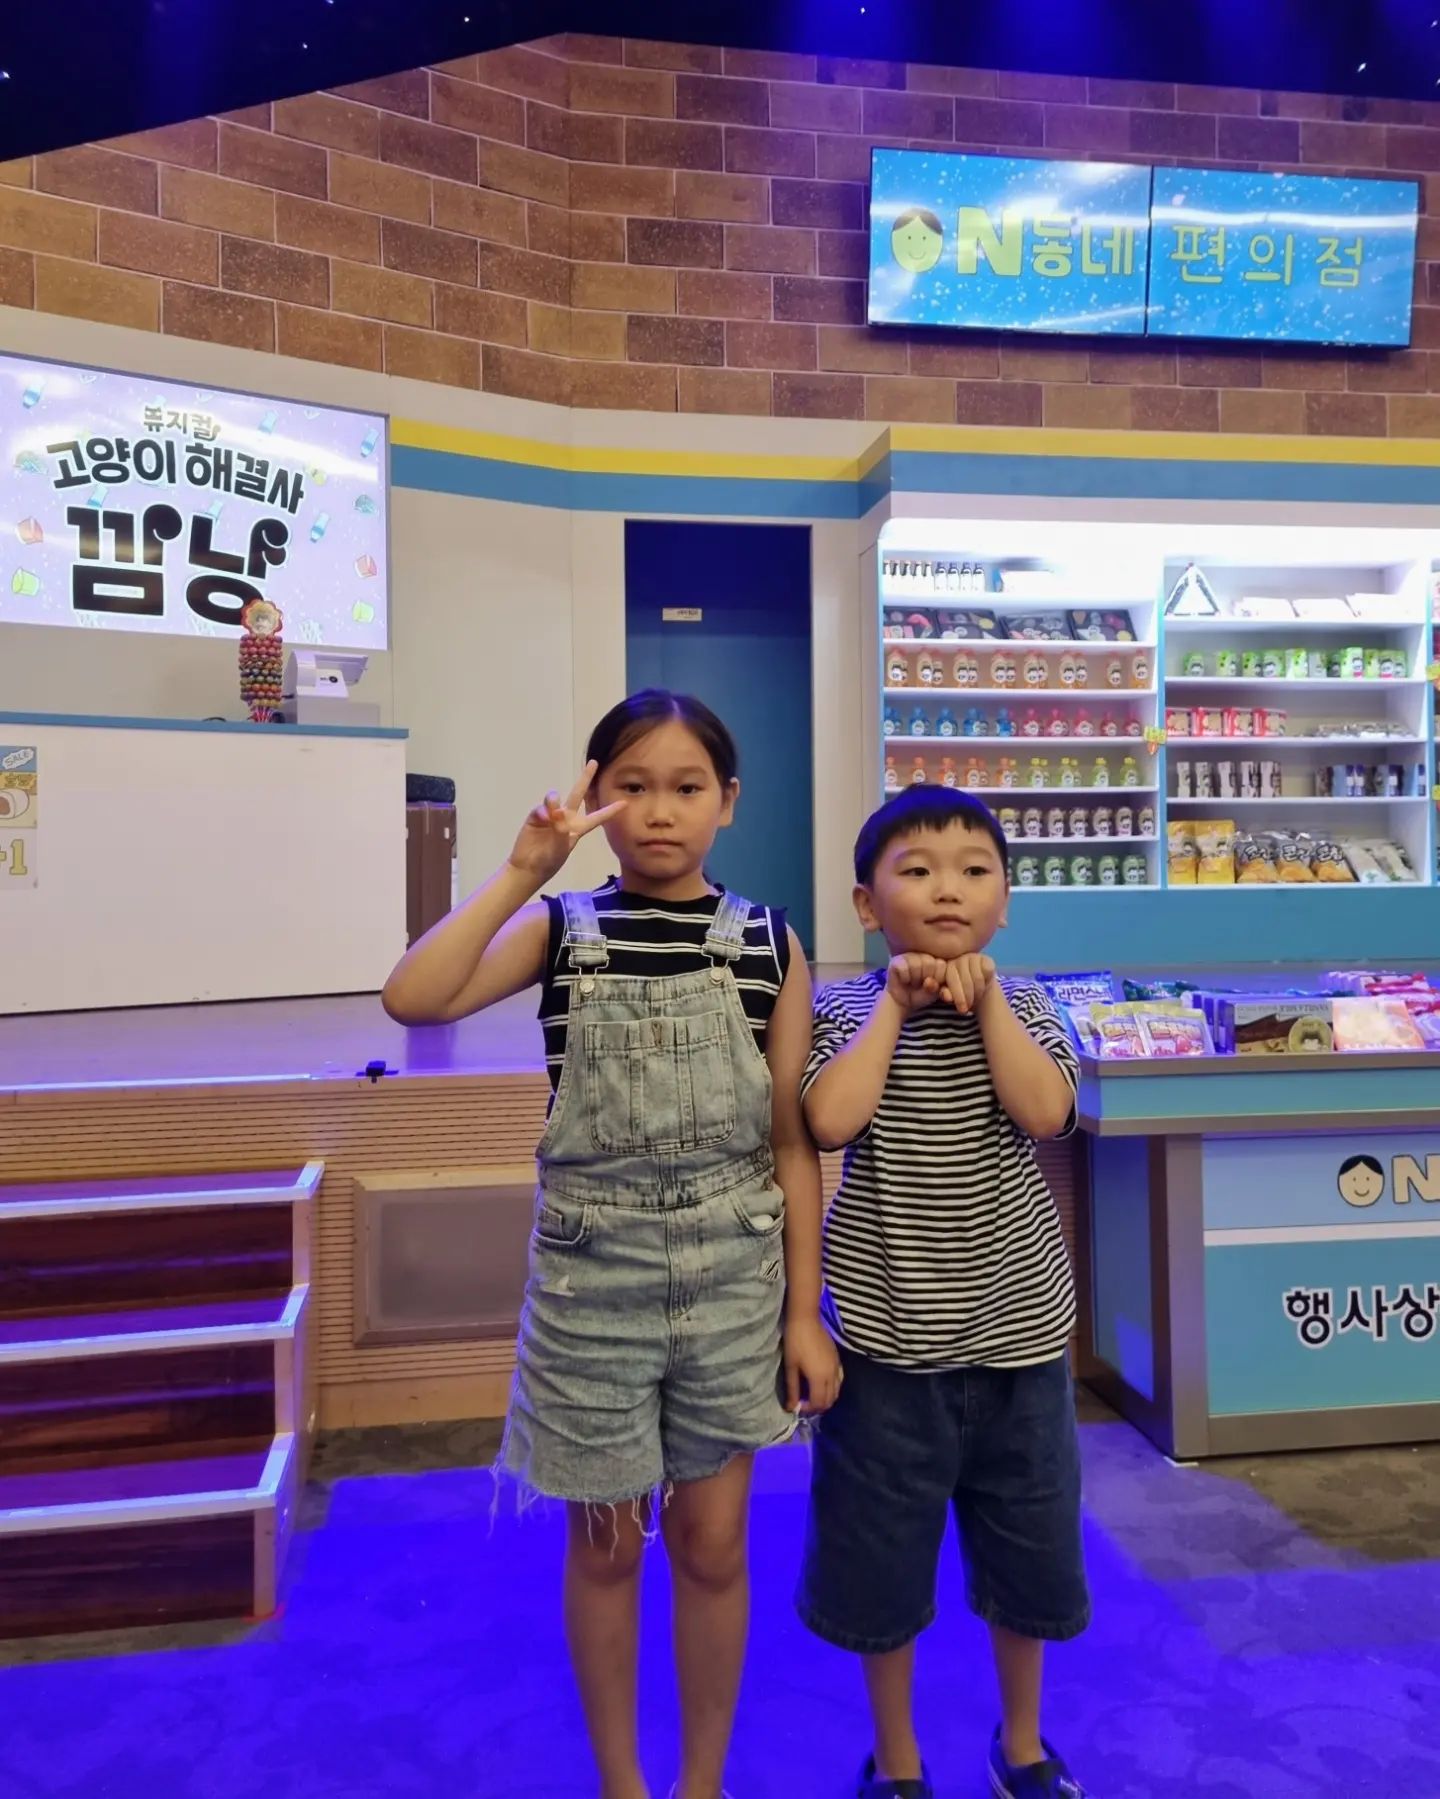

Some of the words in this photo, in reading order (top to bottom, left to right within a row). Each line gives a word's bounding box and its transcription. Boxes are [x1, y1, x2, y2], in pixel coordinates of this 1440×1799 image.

[1170, 222, 1365, 289] 편의점
[143, 405, 221, 442] 뮤지컬
[46, 437, 177, 490] 고양이
[185, 442, 304, 515] 해결사
[66, 503, 290, 626] 깜냥
[5, 751, 31, 767] SALE
[1283, 1284, 1440, 1348] 행사상
